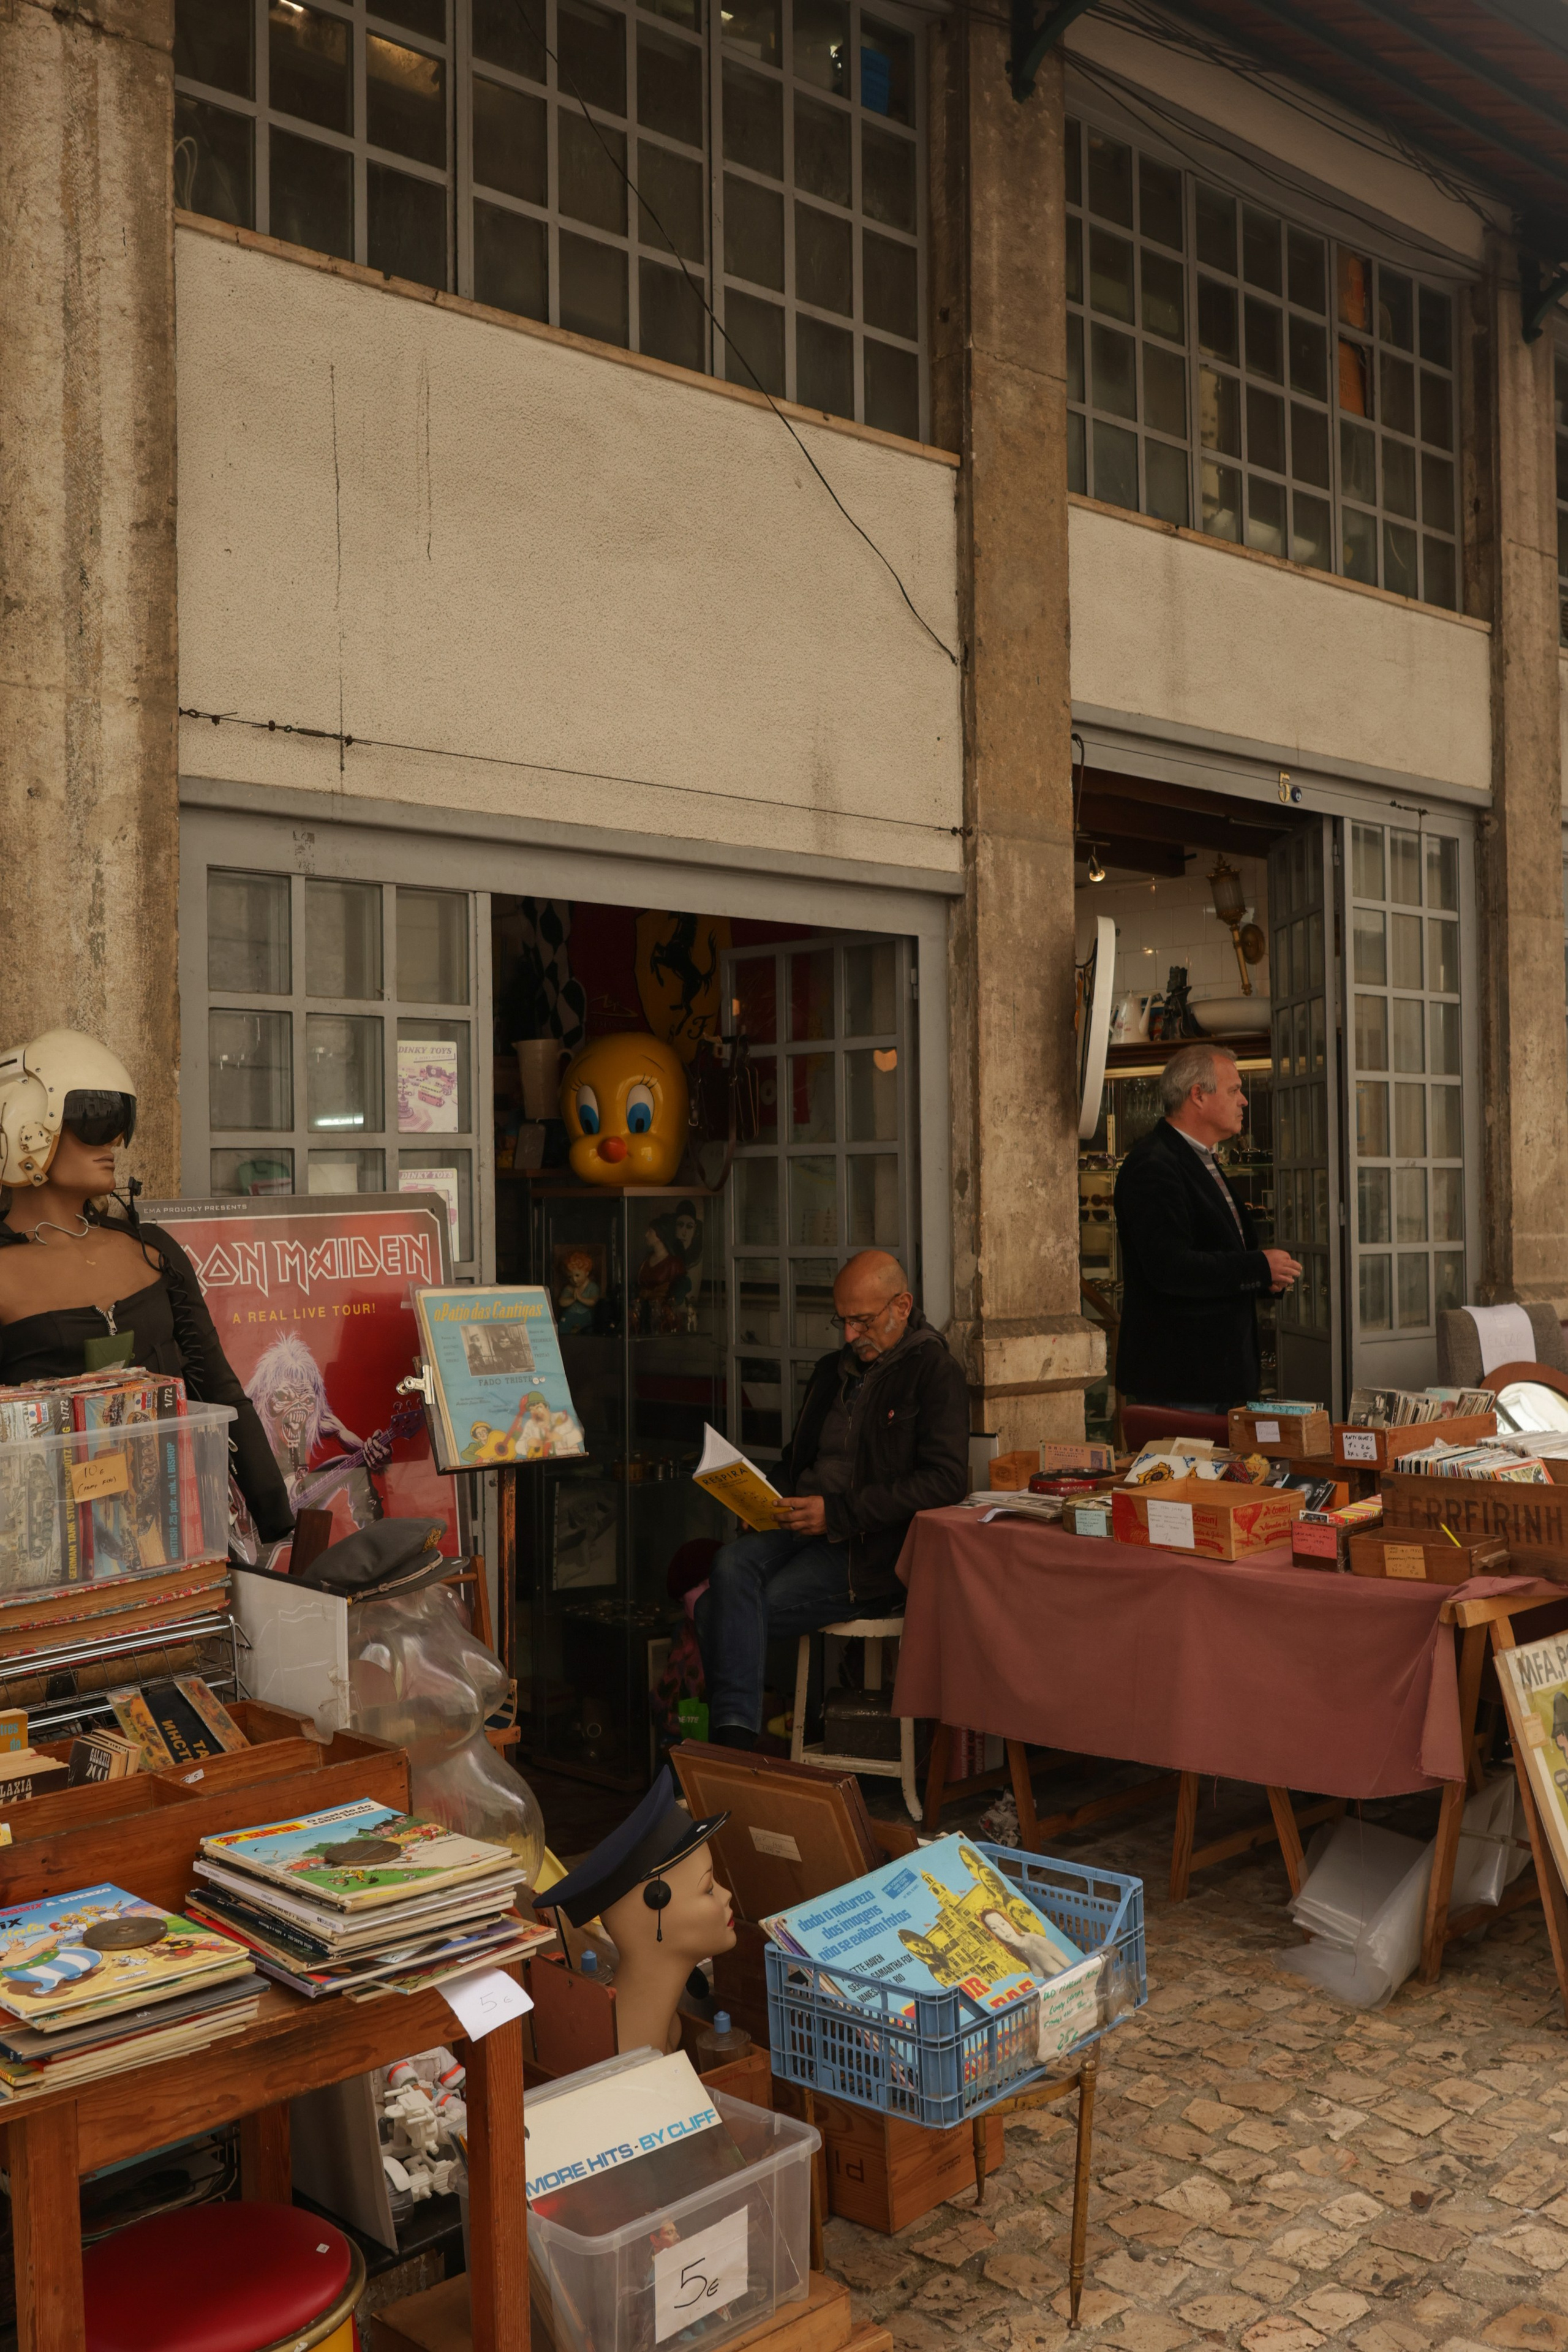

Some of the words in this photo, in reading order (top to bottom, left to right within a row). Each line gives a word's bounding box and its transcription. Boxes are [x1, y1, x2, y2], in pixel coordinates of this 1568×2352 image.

[1278, 771, 1290, 803] 5
[271, 1233, 432, 1295] MAIDEN
[233, 1313, 241, 1324] A
[249, 1309, 287, 1322] REAL
[294, 1306, 326, 1319] LIVE
[332, 1303, 376, 1316] TOUR!
[492, 1300, 543, 1323] Cantigas
[505, 1375, 533, 1384] TRISTE
[164, 1387, 173, 1408] 1/72
[61, 1400, 69, 1420] 1/72
[166, 1442, 176, 1473] BISHOP
[702, 1468, 748, 1485] RESPIRA
[168, 1480, 176, 1495] mk.
[168, 1496, 178, 1513] pdr.
[169, 1515, 178, 1525] 25
[67, 1521, 76, 1544] TANK
[170, 1527, 179, 1558] BRITISH
[69, 1545, 78, 1580] GERMAN
[10, 1738, 21, 1751] da
[89, 1748, 111, 1769] GALAXIA
[317, 1809, 357, 1821] castelo
[58, 1887, 111, 1903] UDERZO
[797, 1913, 827, 1932] dada
[830, 1890, 876, 1917] natureza
[821, 1923, 843, 1940] das
[840, 1905, 883, 1930] imagens
[818, 1945, 842, 1962] não
[837, 1939, 854, 1951] se
[849, 1921, 888, 1946] exibem
[864, 1953, 886, 1969] HAVEN
[870, 1959, 903, 1980] SAMANTHA
[900, 1953, 914, 1965] FOX
[892, 1973, 906, 1985] RIO
[526, 2160, 587, 2198] MORE
[586, 2143, 634, 2172] HITS
[638, 2128, 664, 2151] BY
[666, 2108, 717, 2139] CLIFF
